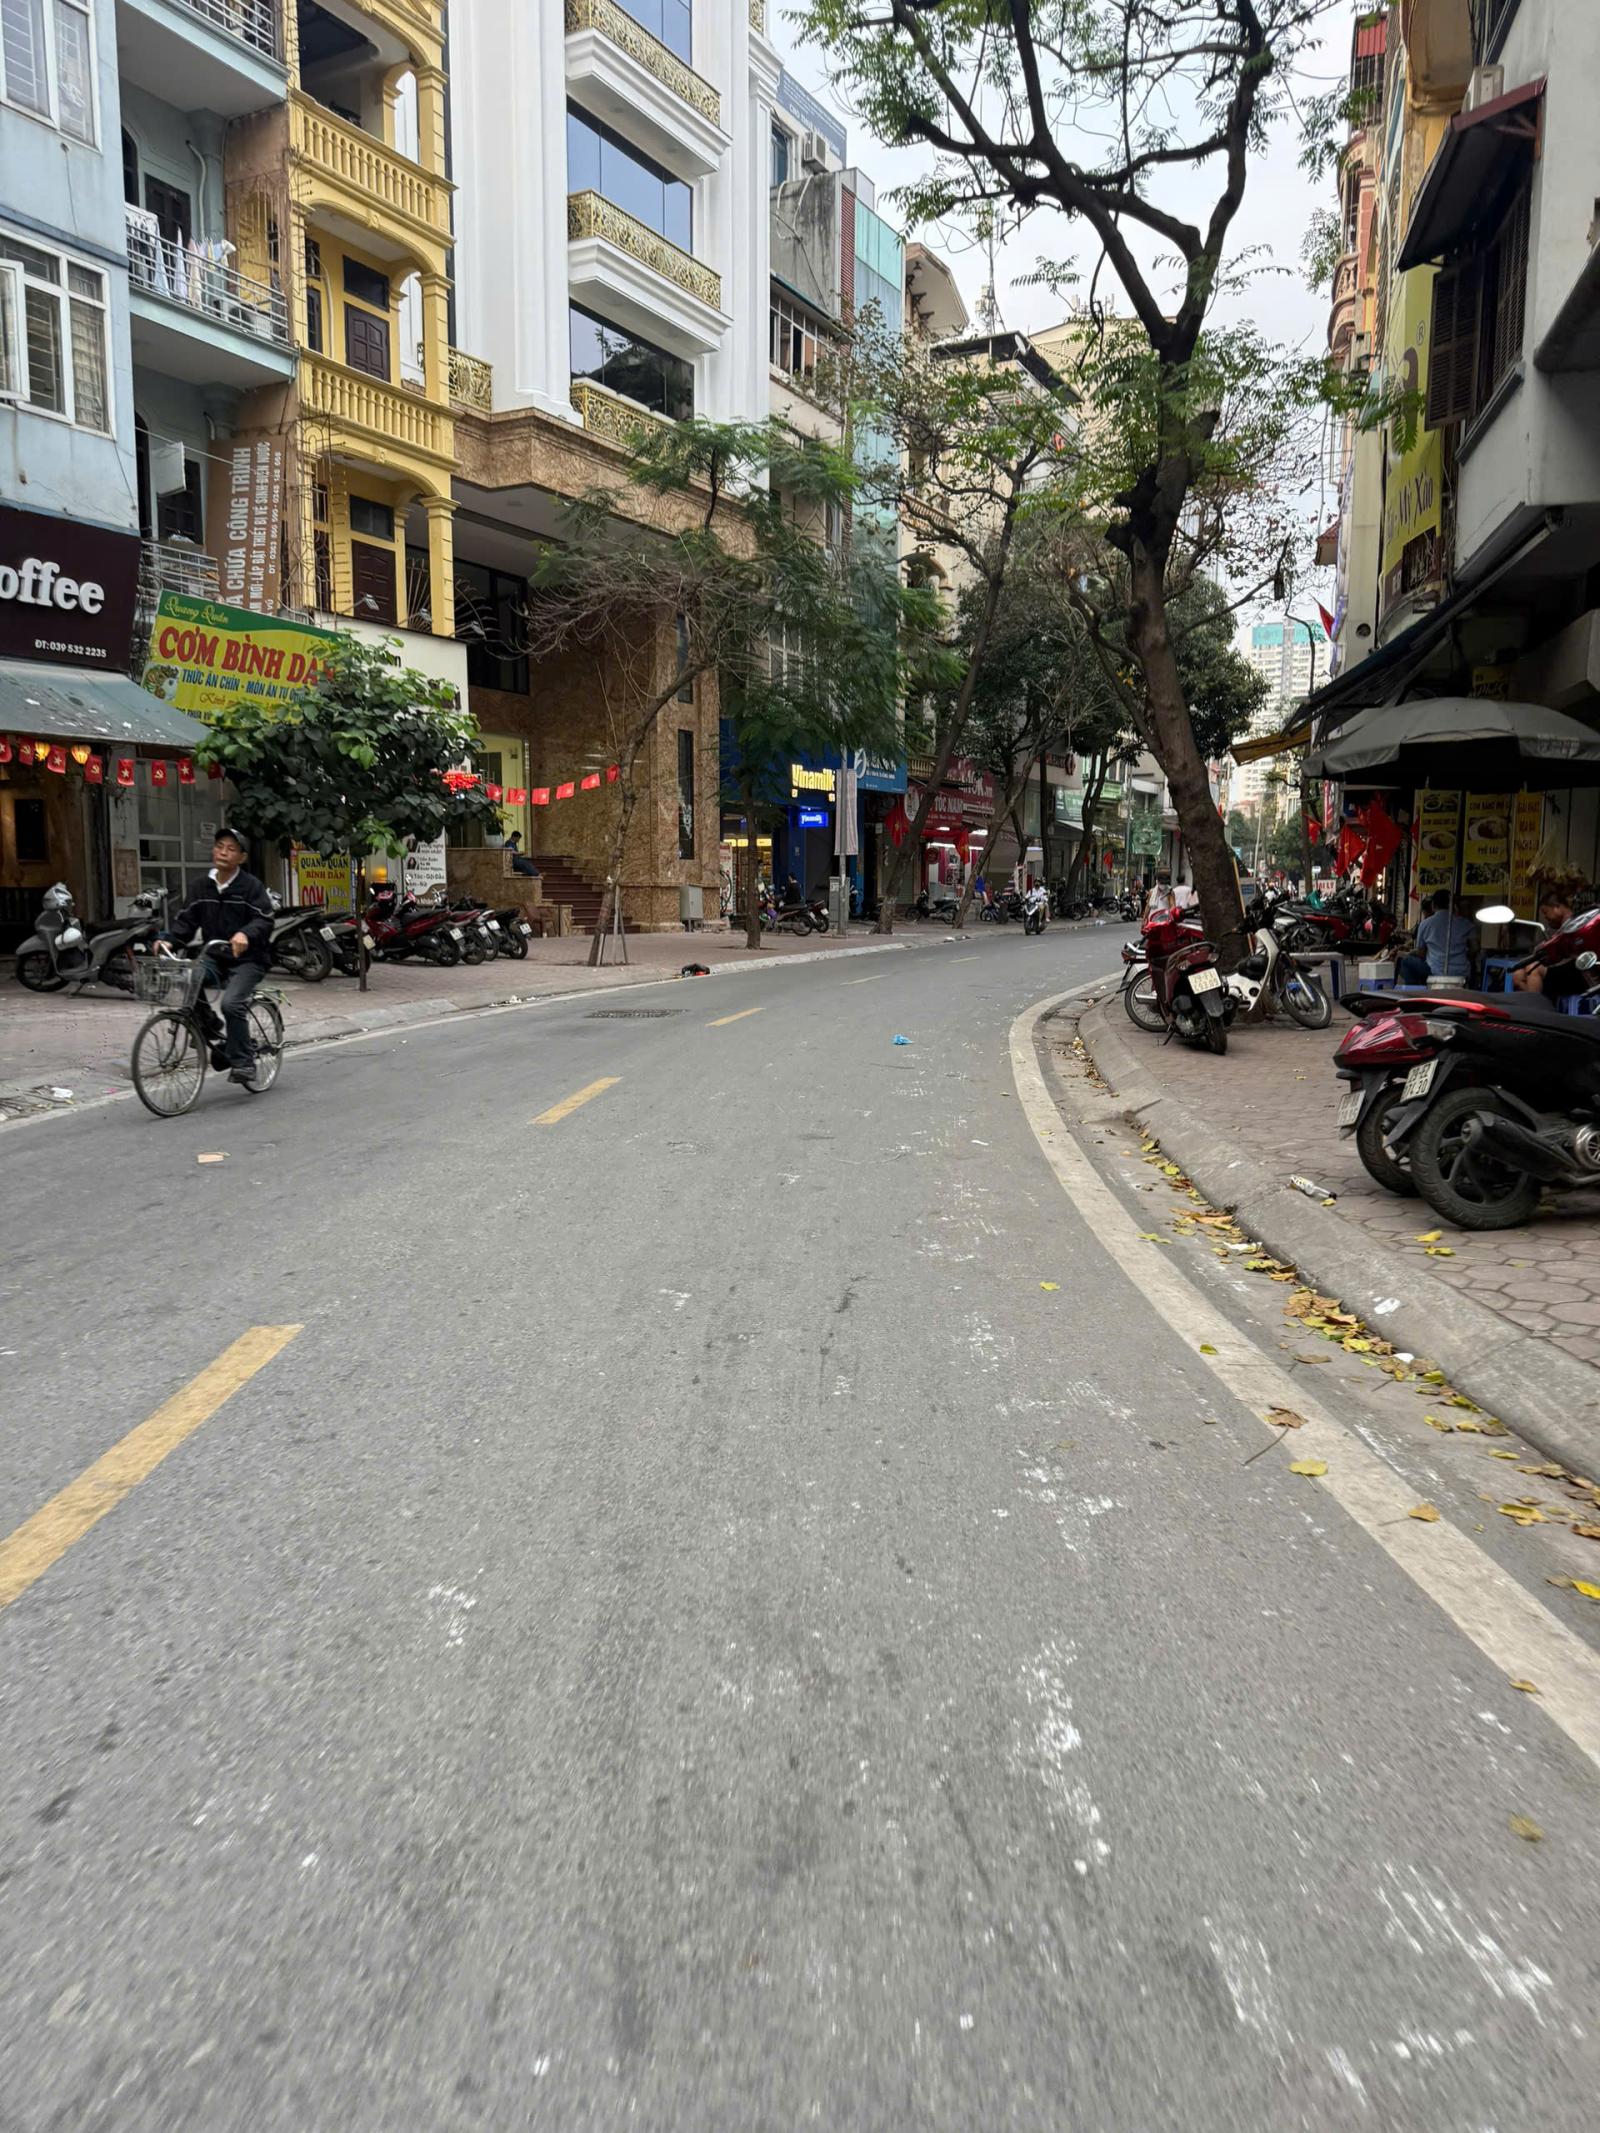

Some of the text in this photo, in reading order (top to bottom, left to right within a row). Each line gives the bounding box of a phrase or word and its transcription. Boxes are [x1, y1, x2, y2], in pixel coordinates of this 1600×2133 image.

[229, 447, 251, 494] TRÌNH
[226, 497, 249, 541] CÔNG
[224, 547, 247, 590] CHỮA
[68, 643, 83, 655] 532
[85, 647, 107, 658] 2235
[159, 626, 219, 668] CƠM
[221, 634, 286, 680] BÌNH
[792, 763, 836, 791] Vinamilk
